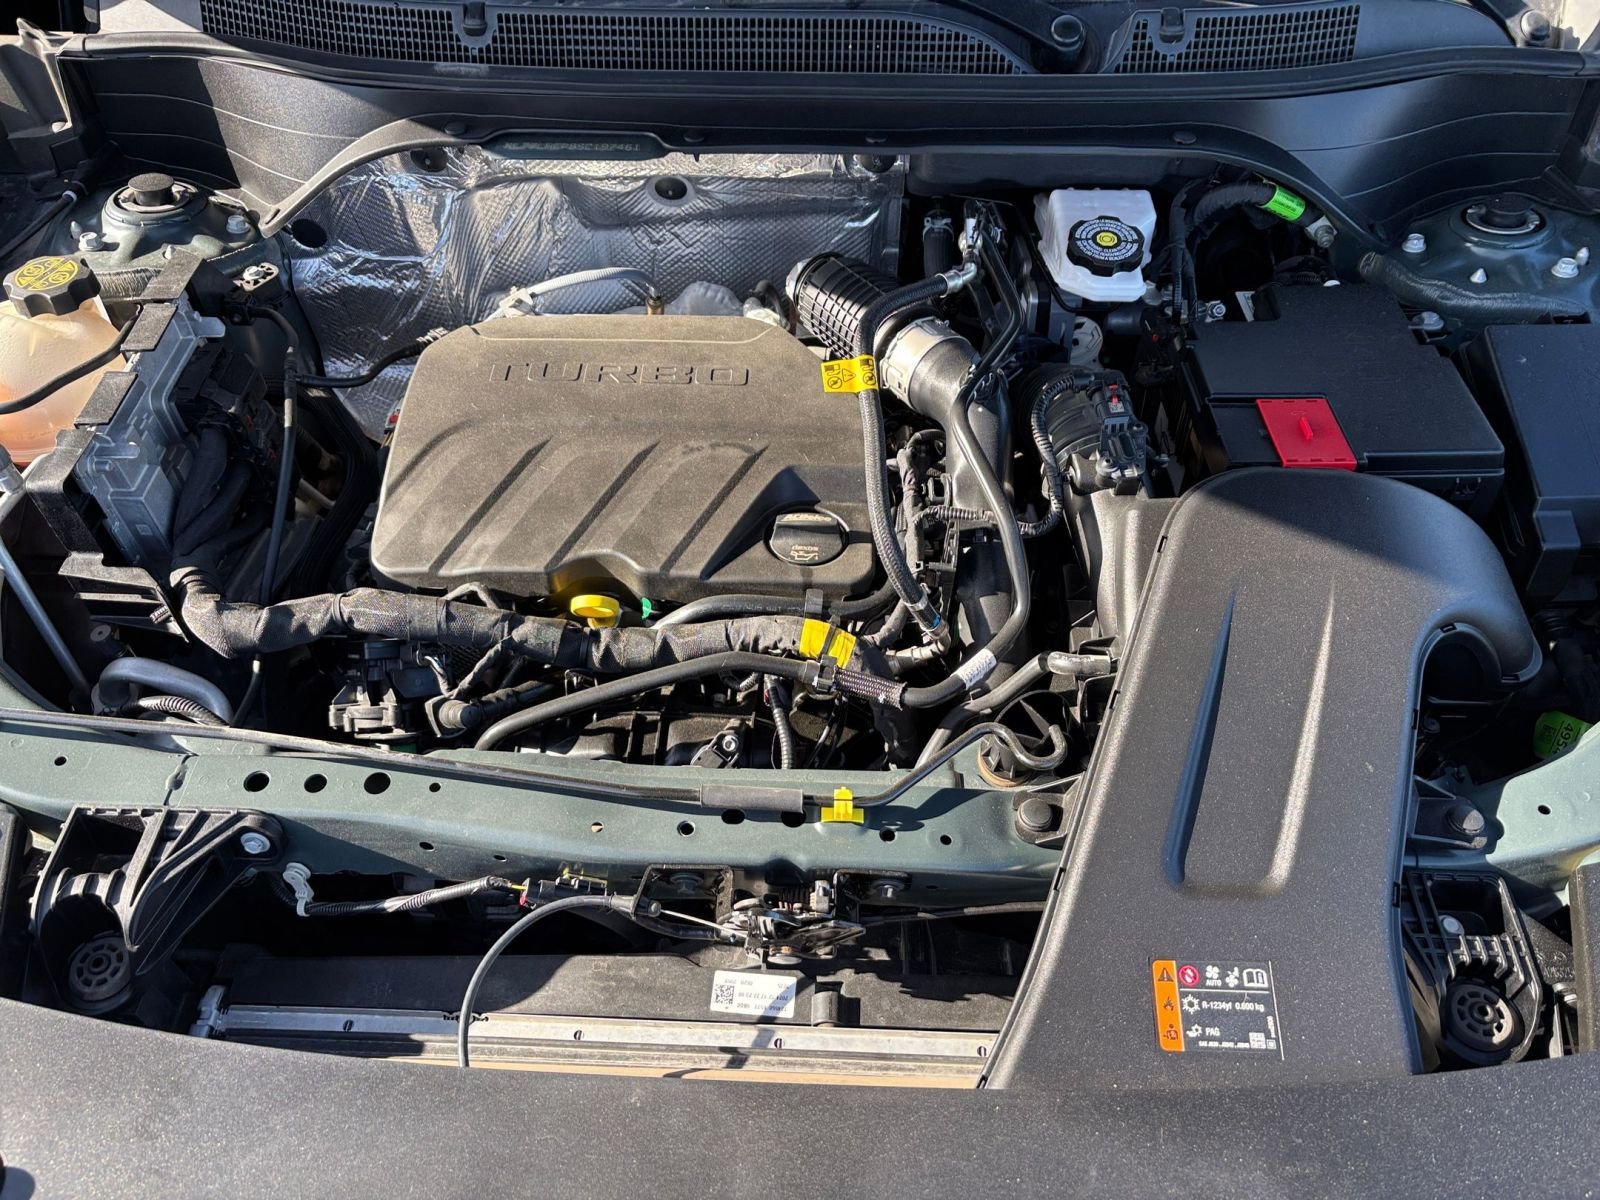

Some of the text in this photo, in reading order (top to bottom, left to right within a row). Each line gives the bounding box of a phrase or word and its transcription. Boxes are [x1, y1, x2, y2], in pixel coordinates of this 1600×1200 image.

[489, 362, 750, 386] TURBO
[1205, 978, 1222, 987] AUTO
[1255, 1002, 1265, 1012] kg
[1205, 1027, 1221, 1036] PAG
